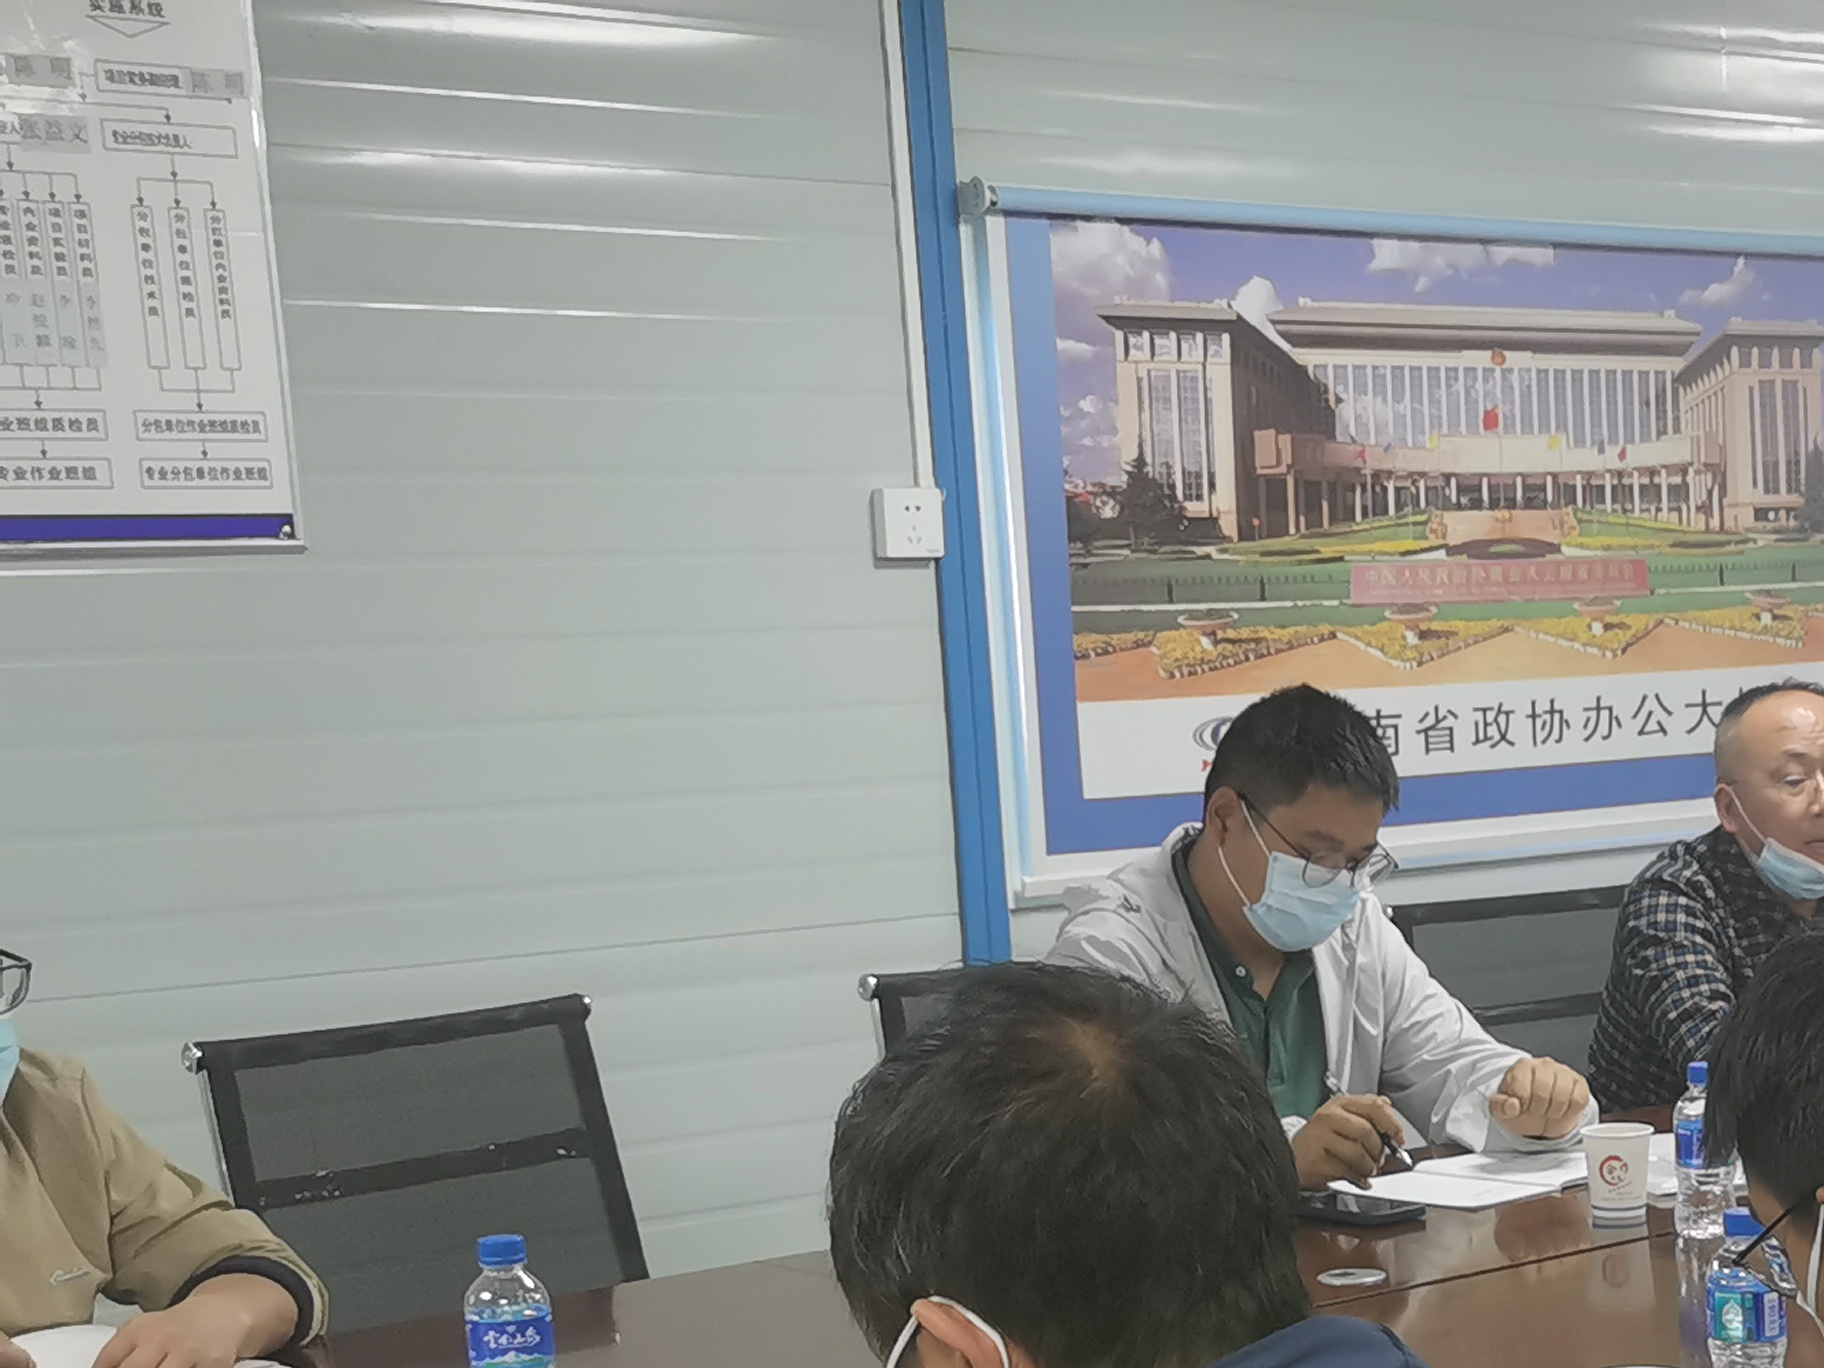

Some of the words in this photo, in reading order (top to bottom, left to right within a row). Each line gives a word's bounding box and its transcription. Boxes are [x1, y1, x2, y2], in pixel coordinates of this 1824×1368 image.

[1362, 686, 1743, 758] 南省政协办公大
